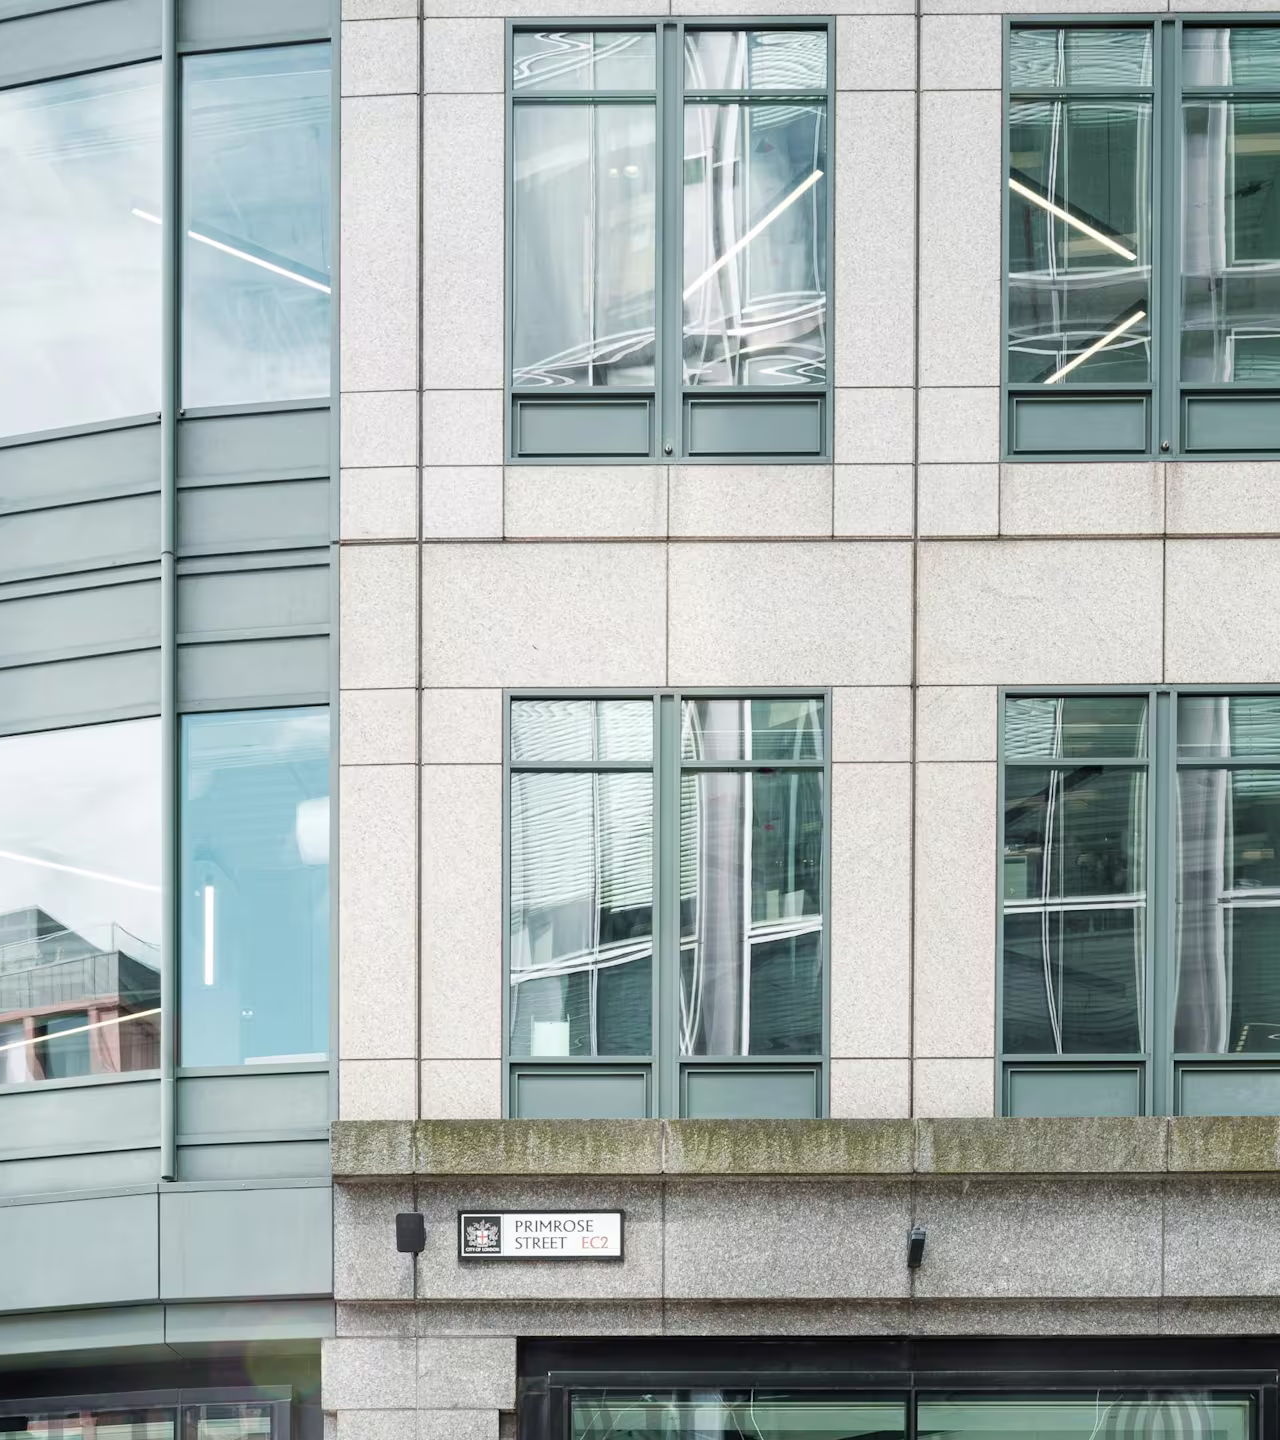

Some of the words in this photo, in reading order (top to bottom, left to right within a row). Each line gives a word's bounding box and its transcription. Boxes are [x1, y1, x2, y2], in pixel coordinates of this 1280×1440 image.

[515, 1219, 594, 1233] PRIMROSE
[515, 1236, 568, 1250] STREET
[582, 1236, 609, 1249] EC2
